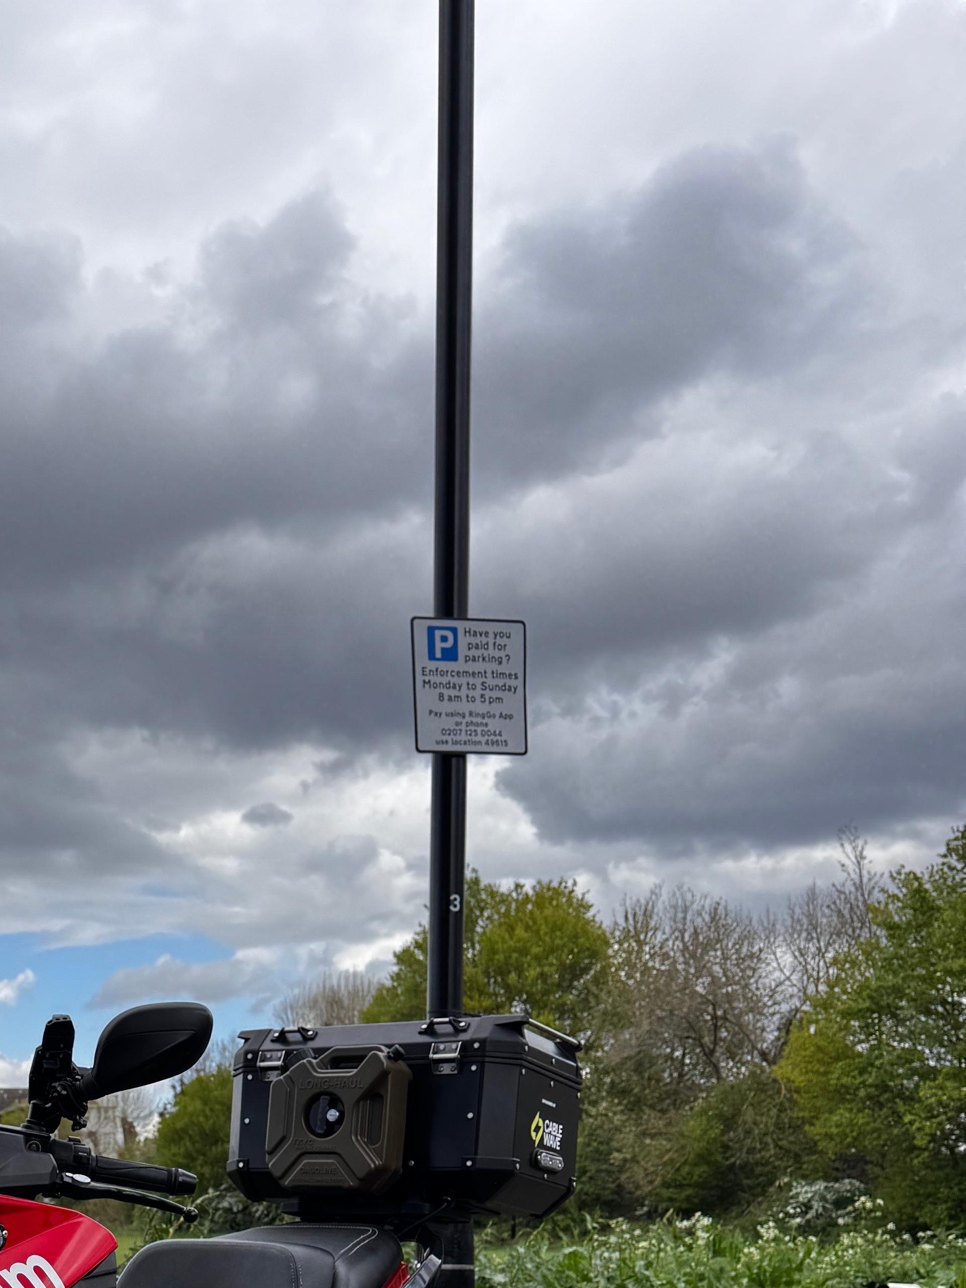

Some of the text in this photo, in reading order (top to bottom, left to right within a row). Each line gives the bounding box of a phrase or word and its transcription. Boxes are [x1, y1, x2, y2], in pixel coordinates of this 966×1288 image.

[464, 627, 511, 639] Have you
[434, 629, 454, 658] P
[467, 641, 507, 651] paid for
[421, 667, 519, 680] Enforcement times
[422, 679, 519, 694] Monday to Sunday
[466, 693, 477, 703] to
[428, 709, 514, 721] Pay using RingGo App
[465, 719, 489, 729] phone
[451, 738, 483, 747] location
[449, 894, 461, 912] 3
[299, 1077, 365, 1090] LONG-HAUL
[544, 1119, 563, 1138] CABLE
[543, 1132, 561, 1151] WAVE
